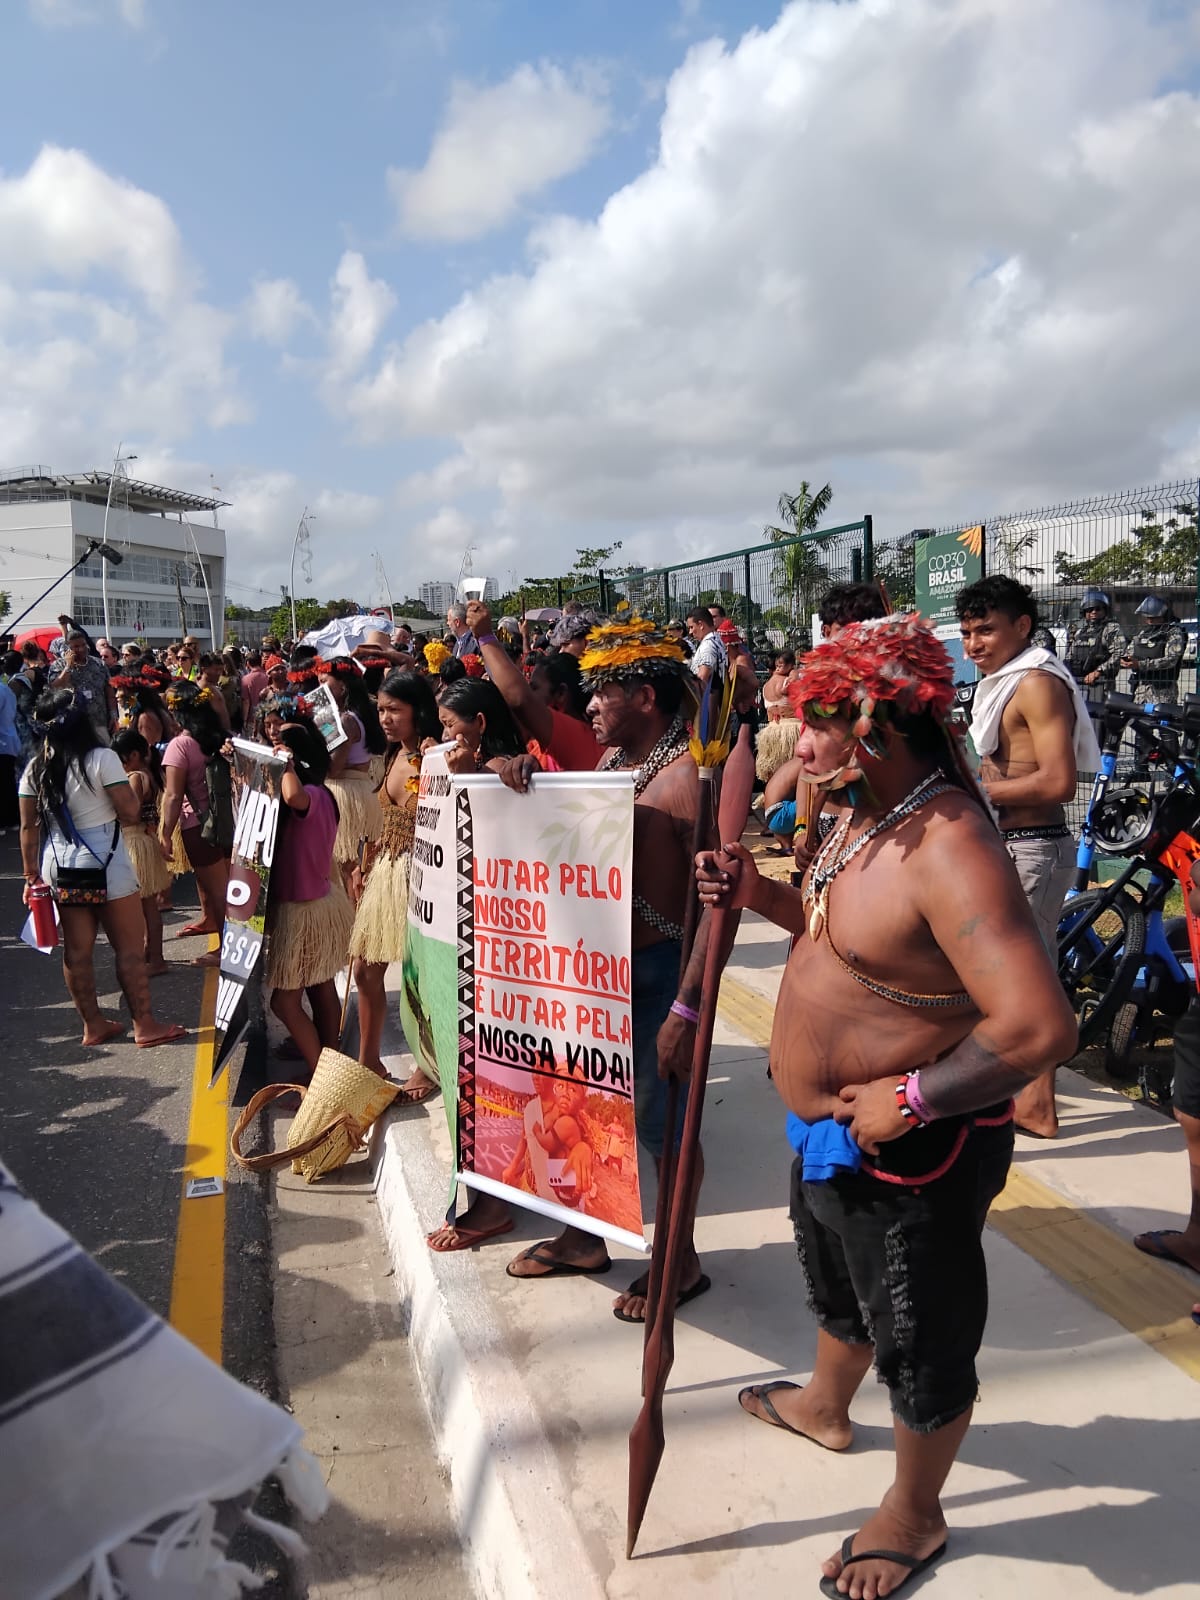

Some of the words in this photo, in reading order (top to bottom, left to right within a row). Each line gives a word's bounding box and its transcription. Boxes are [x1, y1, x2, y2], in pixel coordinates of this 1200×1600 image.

[928, 551, 967, 572] COP30
[928, 567, 967, 587] BRASIL
[1006, 831, 1020, 839] CK
[473, 856, 550, 895] LUTAR
[559, 863, 622, 901] PELO
[475, 894, 546, 932] NOSSO
[475, 935, 630, 995] TERRITÓRIO
[475, 977, 485, 1013] É
[490, 989, 566, 1032] LUTAR
[576, 1004, 632, 1047] PELA
[479, 1022, 556, 1072] NOSSA
[566, 1041, 631, 1093] VIDA!
